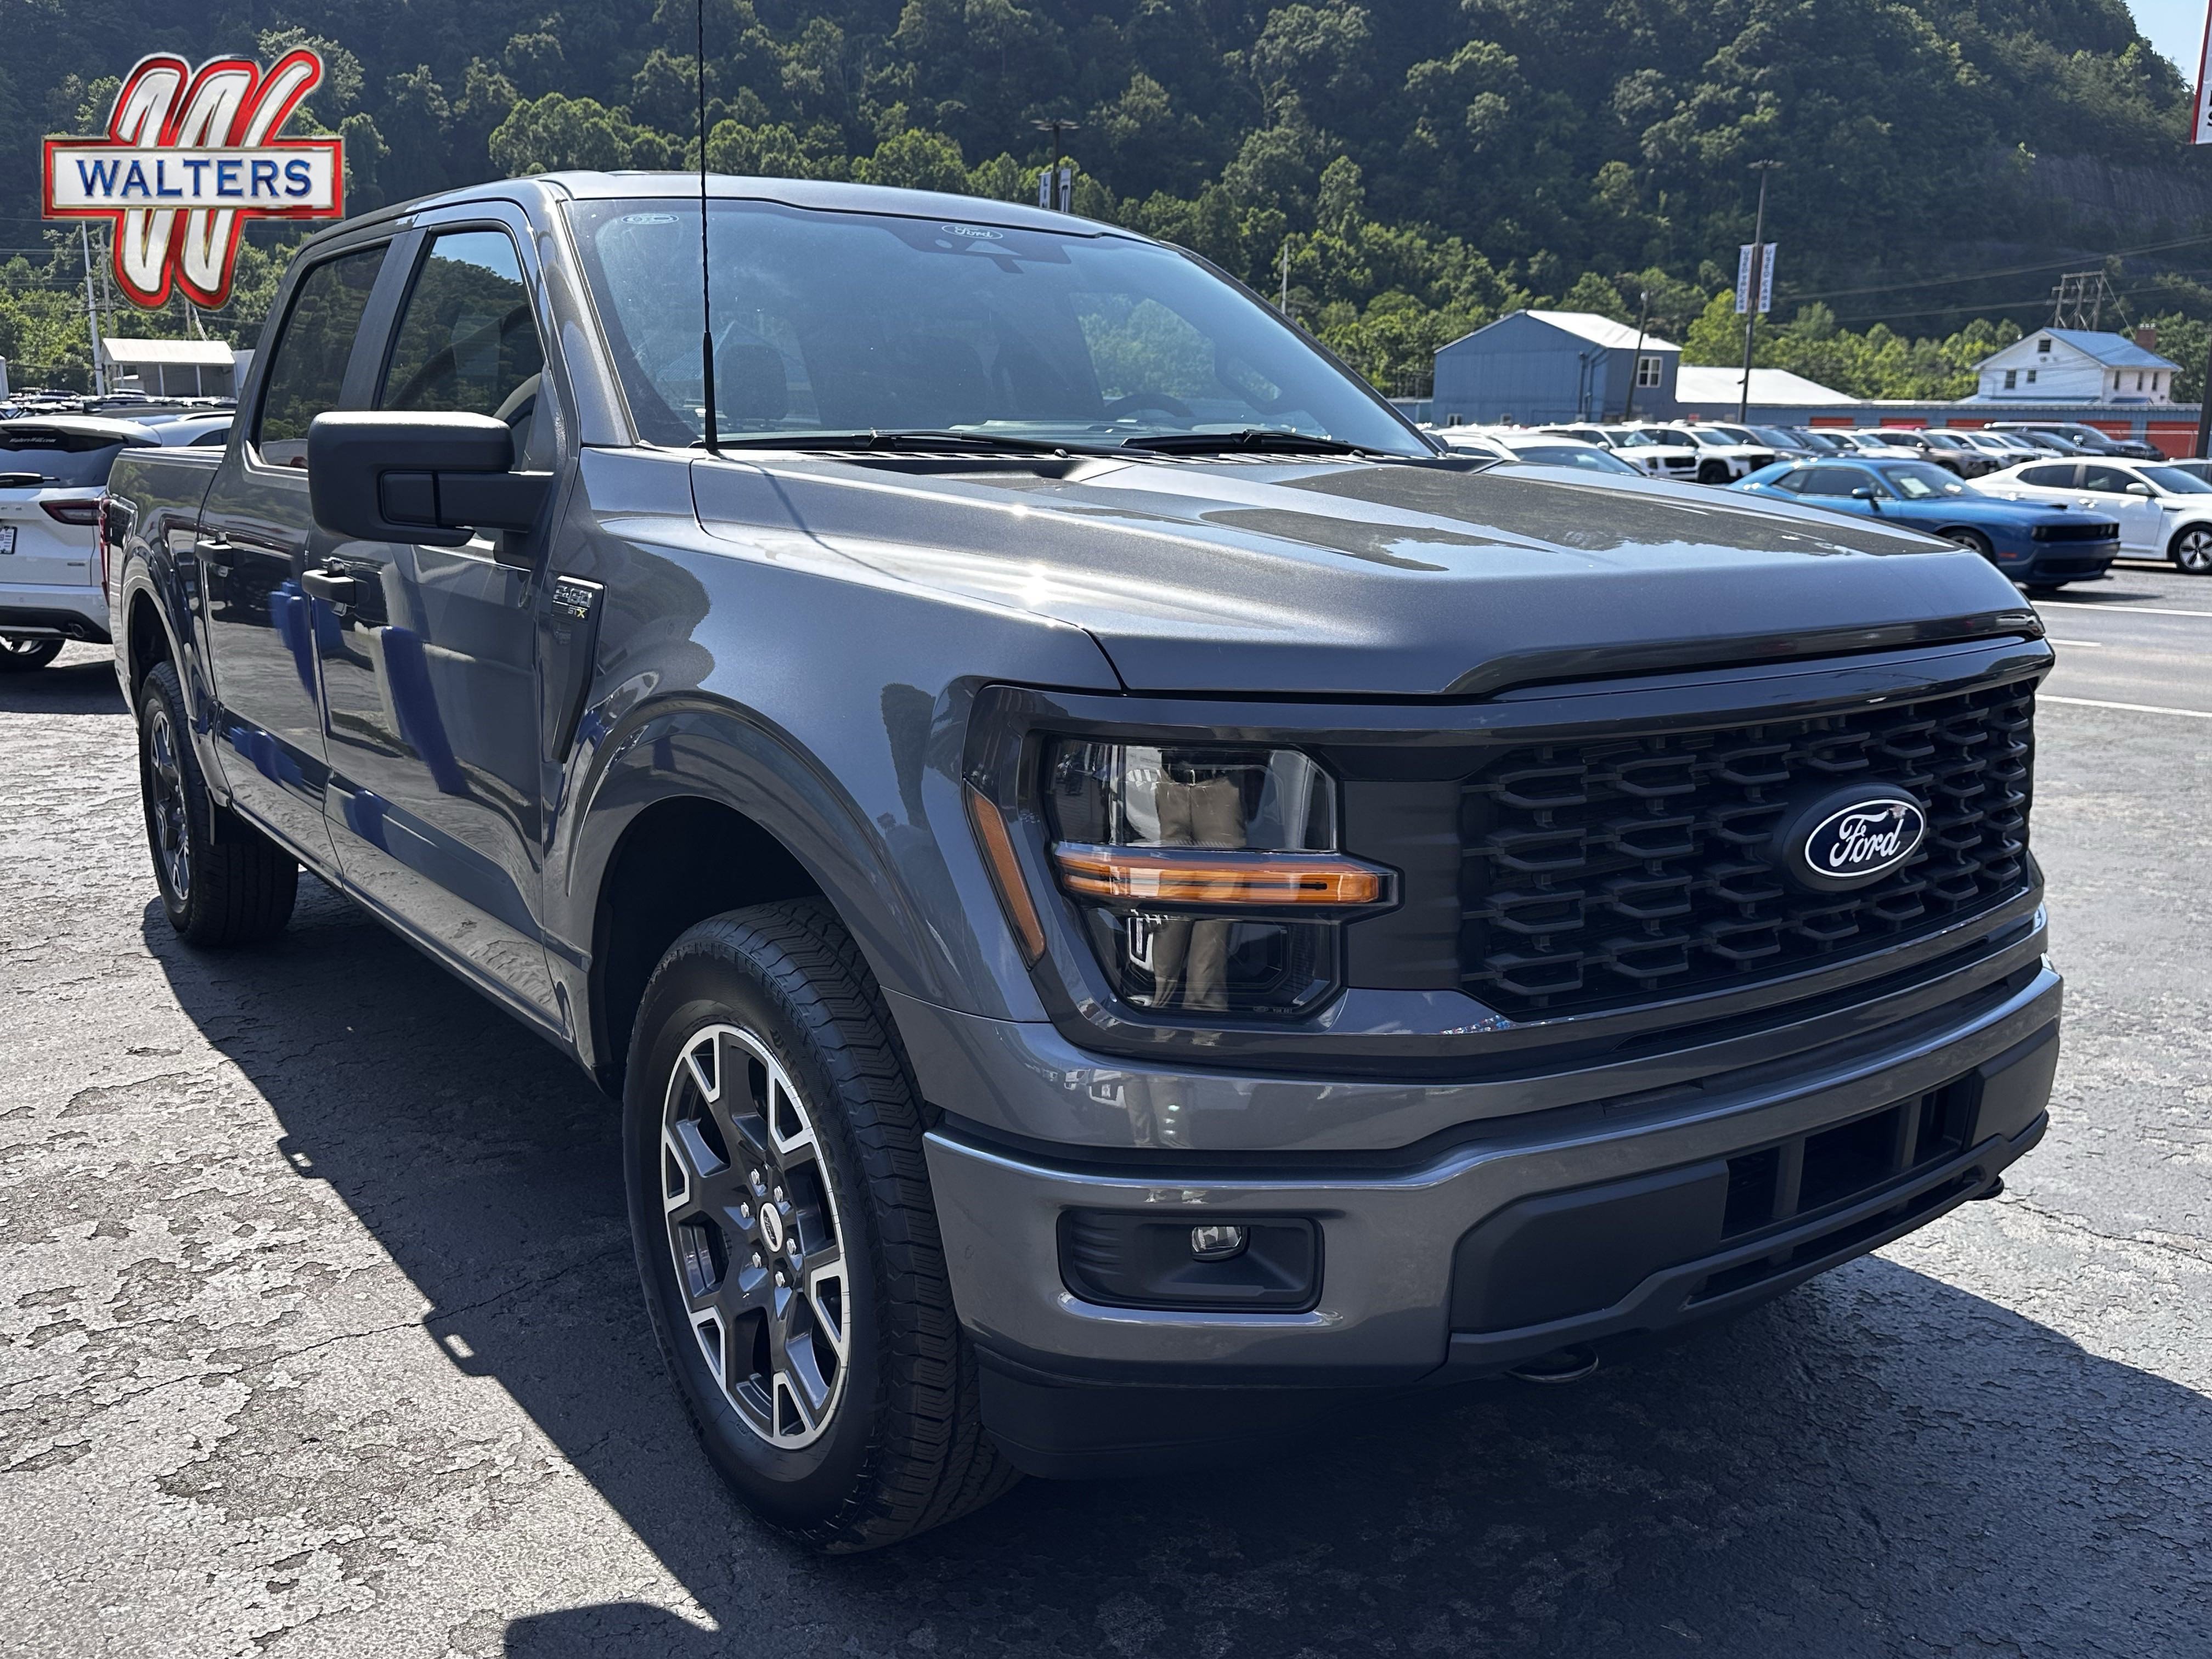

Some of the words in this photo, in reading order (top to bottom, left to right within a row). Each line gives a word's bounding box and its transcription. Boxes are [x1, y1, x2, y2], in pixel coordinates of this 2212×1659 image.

[954, 226, 994, 238] Ford
[568, 607, 585, 618] STX
[1829, 810, 1904, 867] Ford
